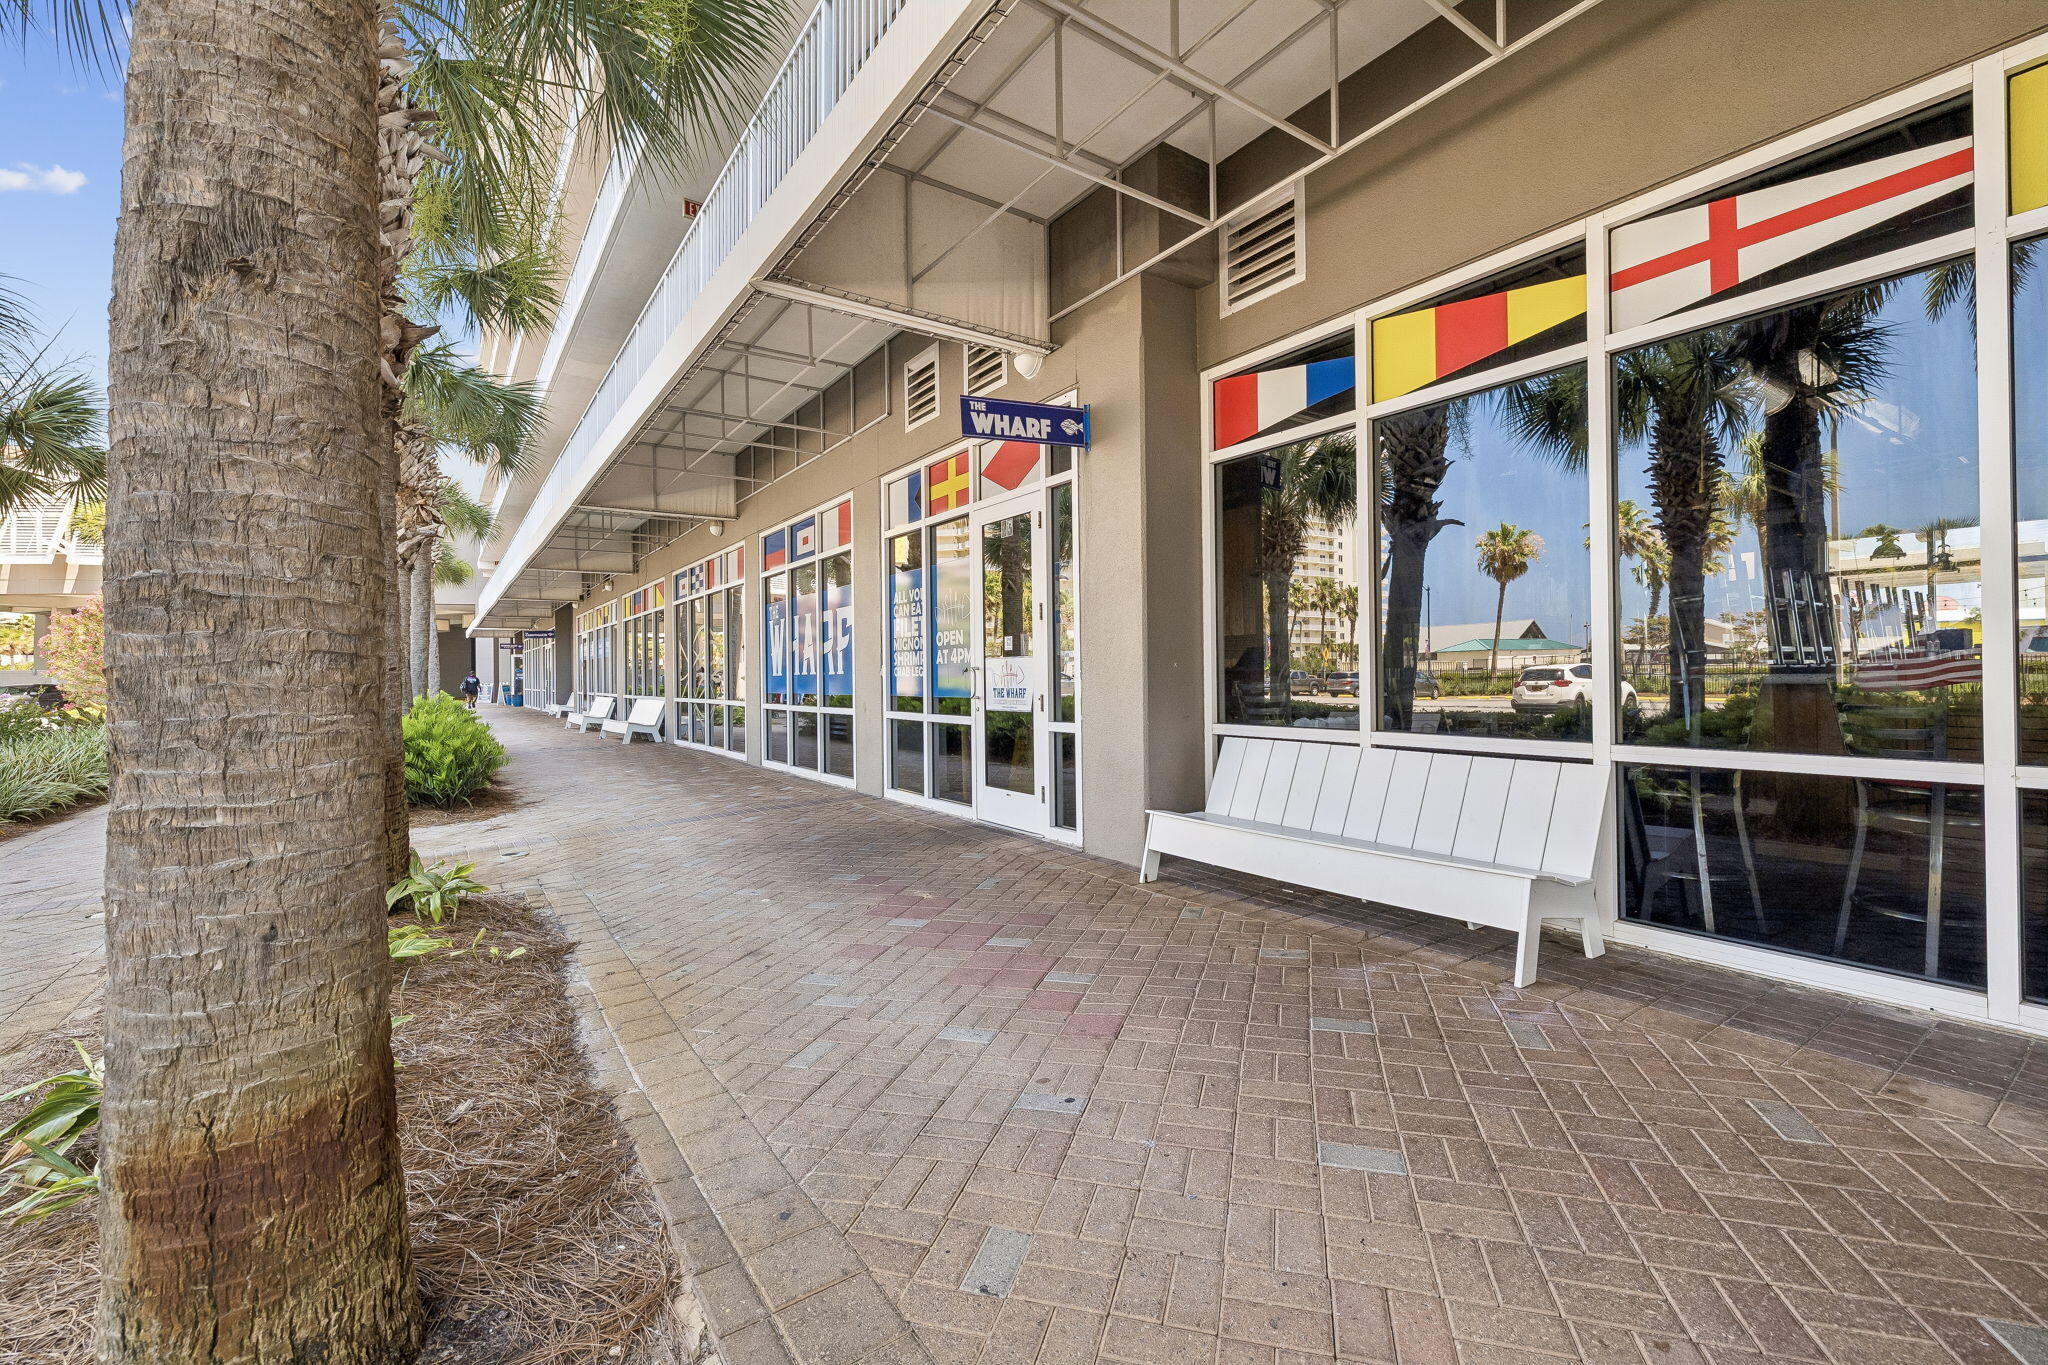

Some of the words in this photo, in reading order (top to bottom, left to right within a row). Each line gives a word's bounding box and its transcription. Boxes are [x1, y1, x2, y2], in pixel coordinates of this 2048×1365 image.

[969, 400, 987, 411] THE
[970, 411, 1051, 439] WHARF
[894, 590, 908, 604] ALL
[909, 587, 923, 601] YO
[894, 603, 909, 618] CAN
[911, 602, 923, 616] EA
[936, 629, 963, 646] OPEN
[936, 649, 949, 664] AT
[950, 648, 972, 663] 4PM
[993, 687, 1005, 699] THE
[1006, 687, 1027, 699] WHARF
